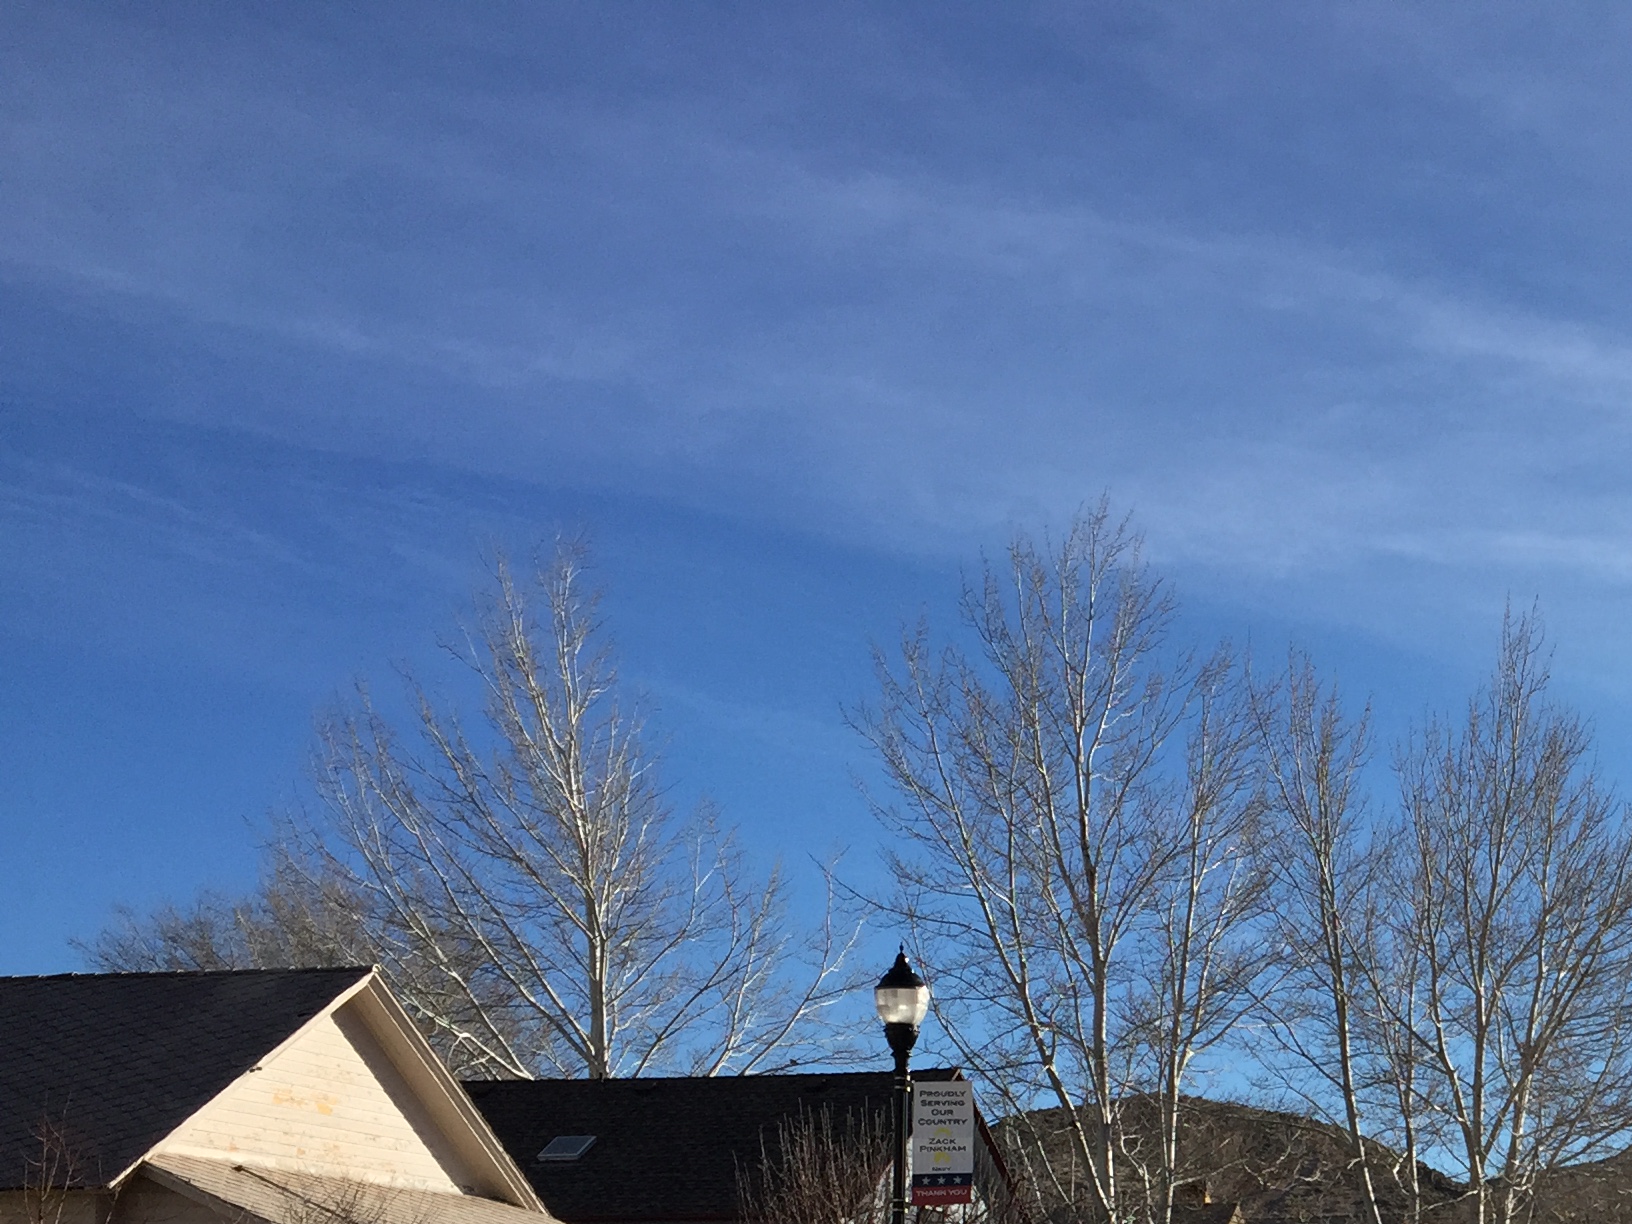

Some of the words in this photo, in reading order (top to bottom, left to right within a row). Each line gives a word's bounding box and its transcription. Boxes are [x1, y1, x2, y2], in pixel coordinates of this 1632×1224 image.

[919, 1090, 966, 1098] PROUDLY
[920, 1099, 966, 1107] SERVING
[931, 1108, 954, 1116] OUR
[917, 1117, 968, 1126] COUNTRY
[928, 1137, 957, 1145] ZACK
